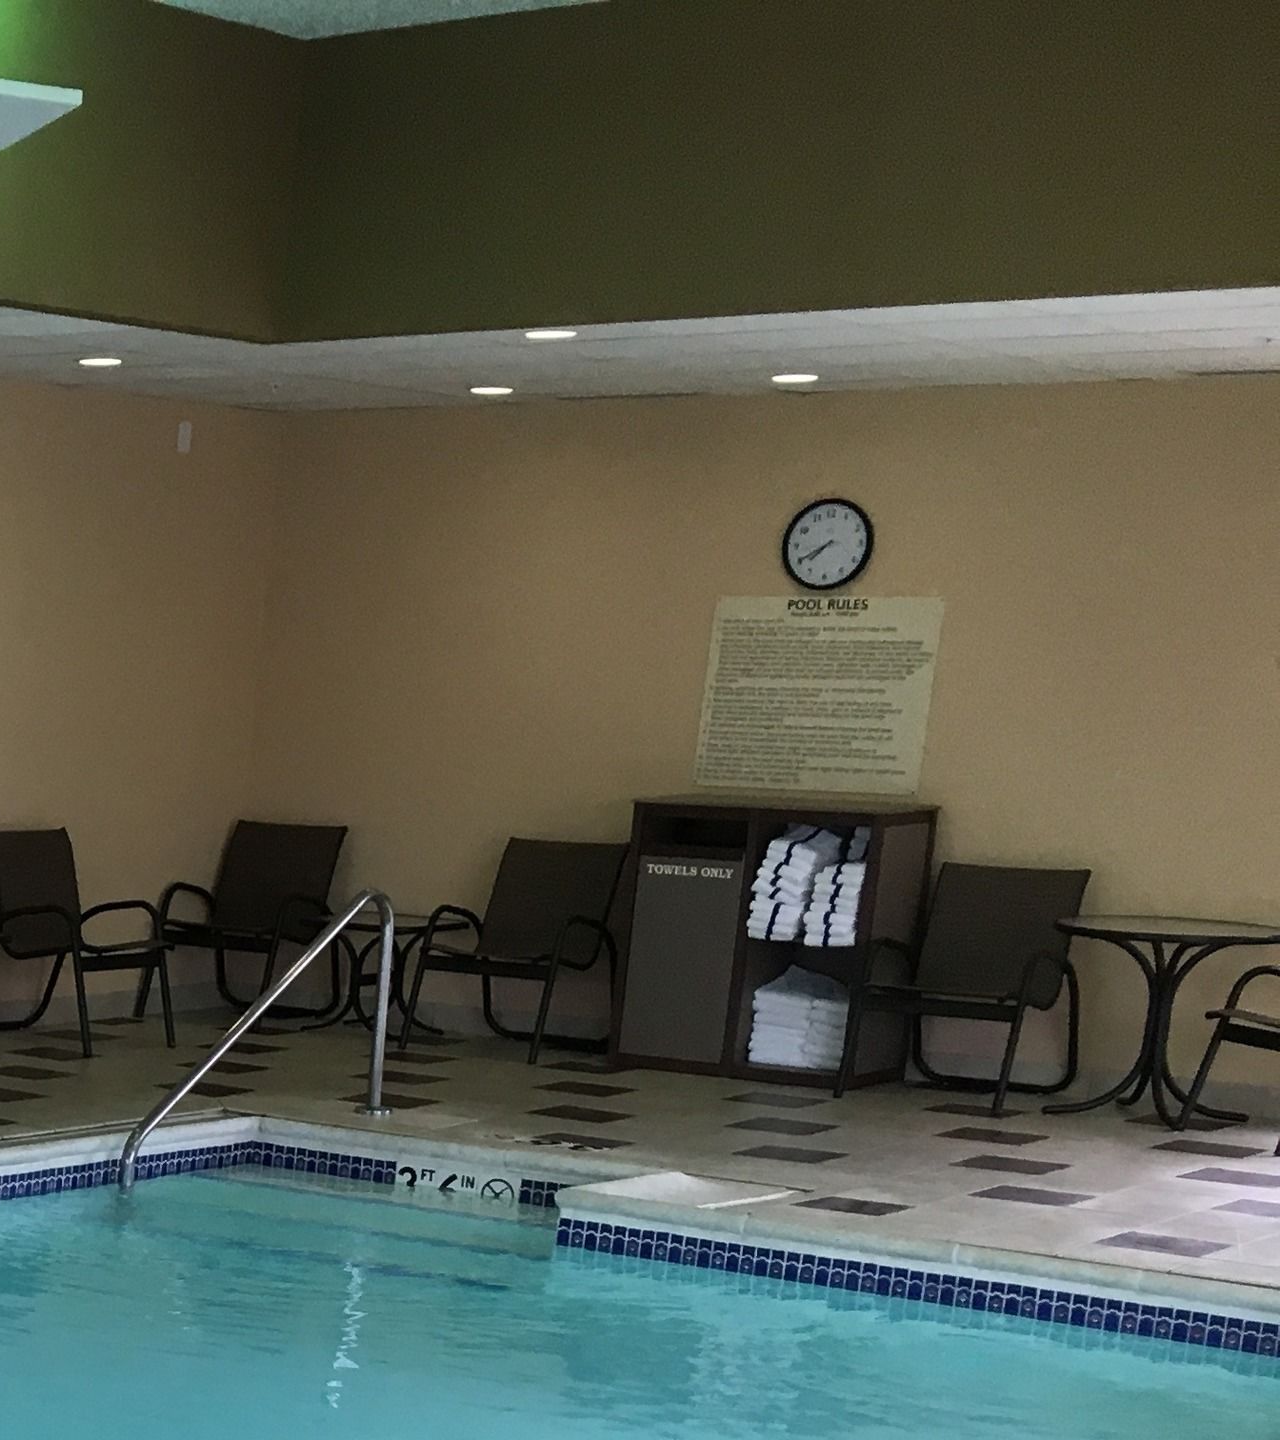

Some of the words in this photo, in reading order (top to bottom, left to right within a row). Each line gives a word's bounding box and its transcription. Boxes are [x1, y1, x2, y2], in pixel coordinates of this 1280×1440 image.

[787, 598, 823, 610] POOL
[827, 598, 869, 610] RULES
[647, 863, 698, 876] TOWELS
[700, 867, 734, 879] ONLY
